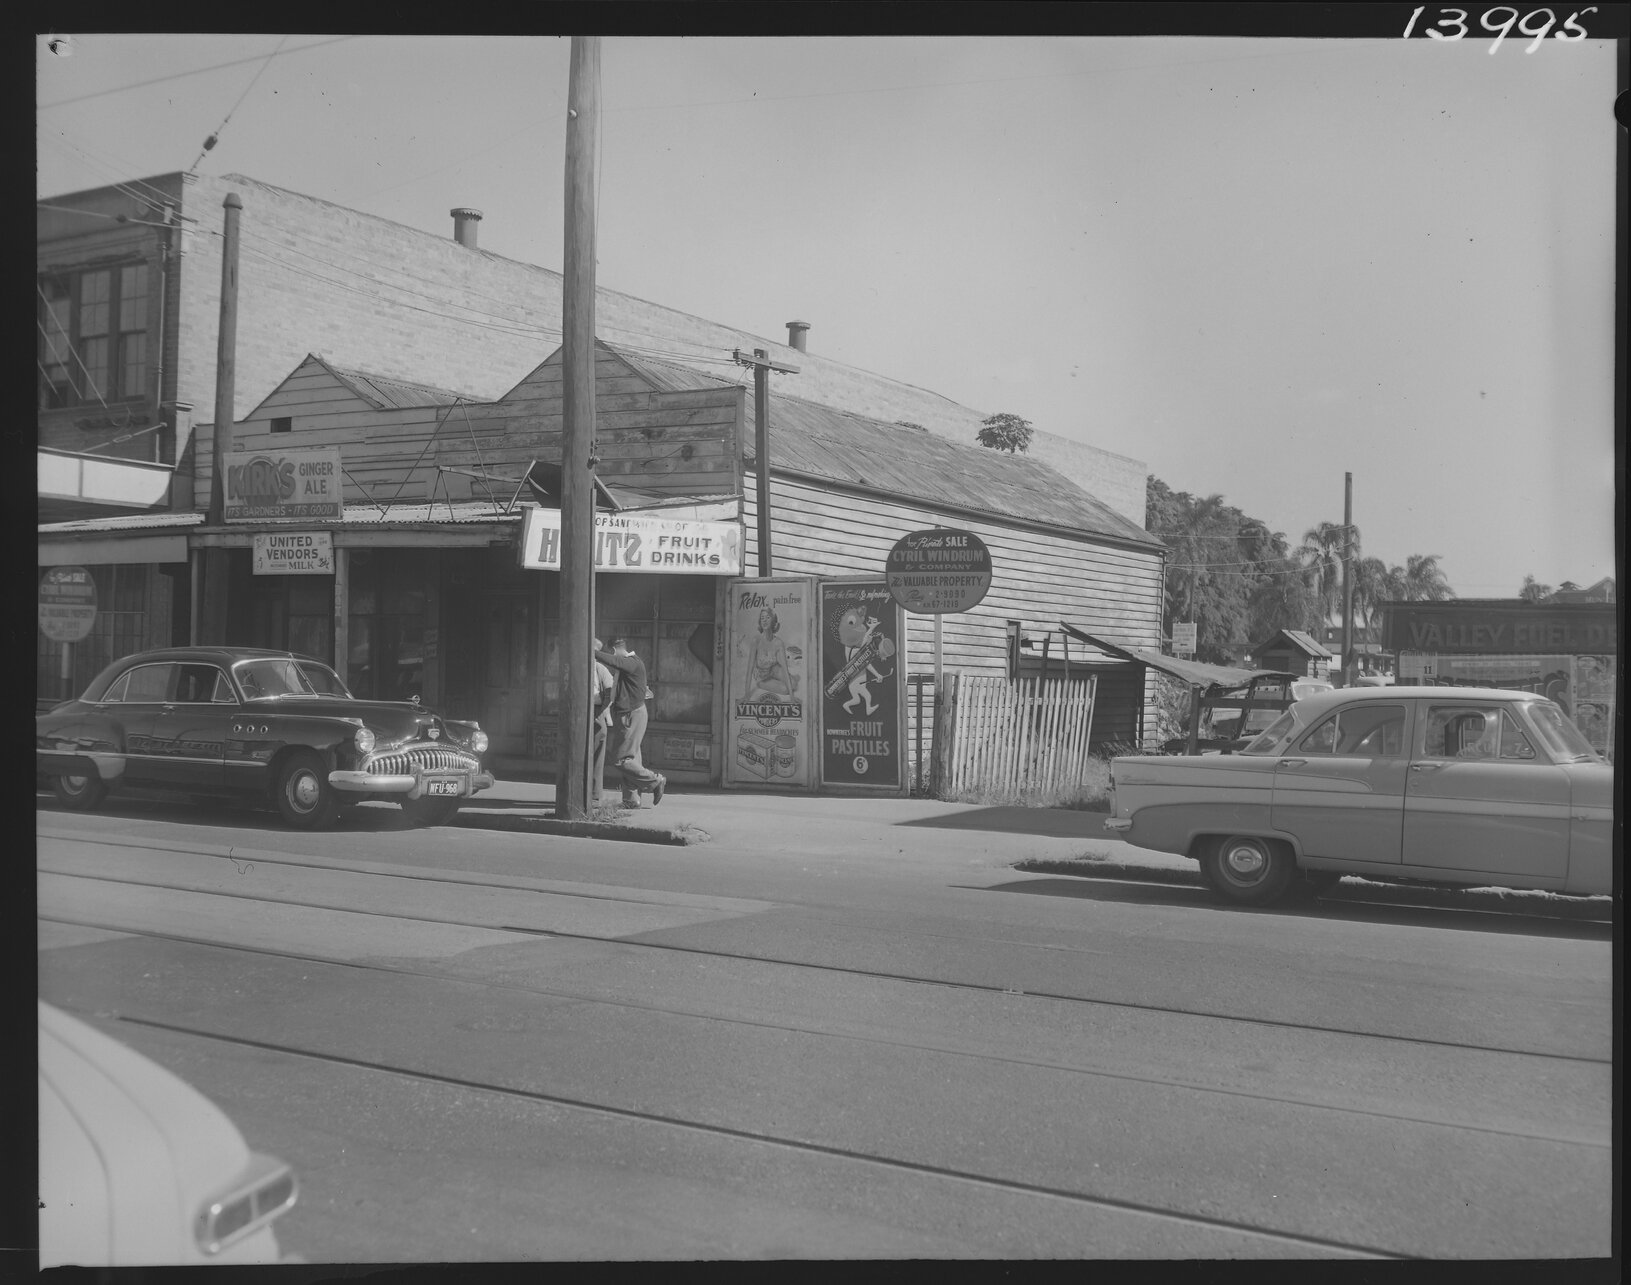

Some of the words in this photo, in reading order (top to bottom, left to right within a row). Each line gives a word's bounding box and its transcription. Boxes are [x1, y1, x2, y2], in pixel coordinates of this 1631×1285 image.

[299, 462, 333, 476] GINGER
[228, 457, 297, 501] KIRK'S
[304, 480, 327, 495] ALE
[242, 506, 286, 517] GARDNERS
[310, 504, 334, 515] GOOD
[270, 536, 313, 548] UNITED
[659, 535, 713, 549] FRUIT
[945, 536, 968, 548] SALE
[266, 549, 318, 560] VENDORS
[652, 551, 722, 566] DRINKS
[893, 550, 925, 562] CYRIL
[927, 550, 984, 562] WINDRUM
[289, 561, 314, 570] MILK
[903, 576, 938, 587] VALUABLE
[773, 596, 787, 608] pain
[787, 593, 802, 604] free
[1408, 622, 1508, 648] VALLEY
[1514, 622, 1577, 648] FUEL
[738, 703, 801, 717] VINCENT'S
[850, 721, 884, 737] FRUIT
[831, 739, 891, 757] PASTILLES
